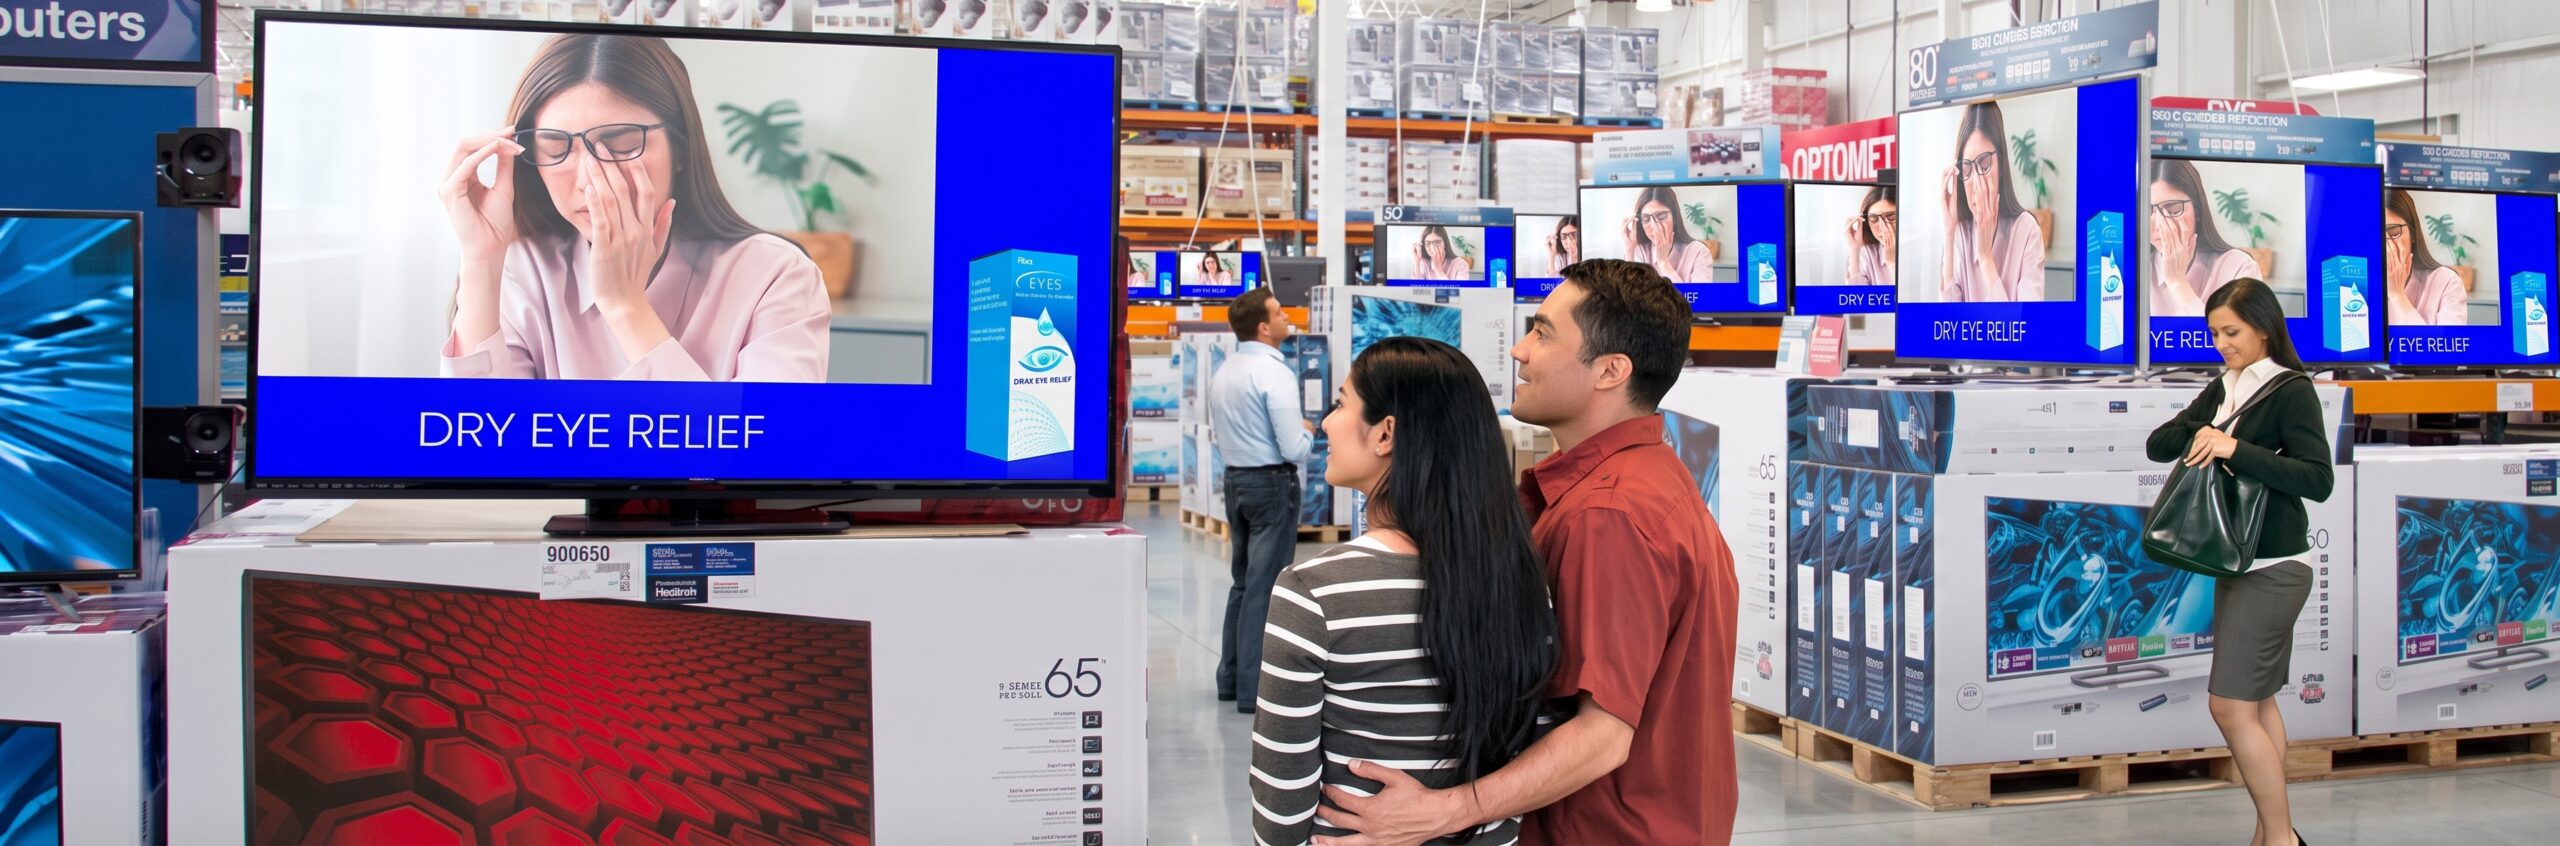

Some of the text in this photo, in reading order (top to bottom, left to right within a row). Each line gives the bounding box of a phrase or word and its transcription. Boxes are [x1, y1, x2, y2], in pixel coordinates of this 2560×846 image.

[1029, 277, 1062, 291] EYES
[1839, 294, 1891, 306] DRY EYE
[1933, 321, 2027, 342] DRY EYE RELIEF
[2399, 337, 2424, 353] EYE
[2427, 337, 2470, 353] RELIEF
[1013, 376, 1072, 386] DRAX EYE RELIEF
[418, 411, 766, 449] DRY EYE RELIEF
[1760, 454, 1777, 480] 65
[546, 545, 611, 563] 900650
[1044, 657, 1102, 698] 65
